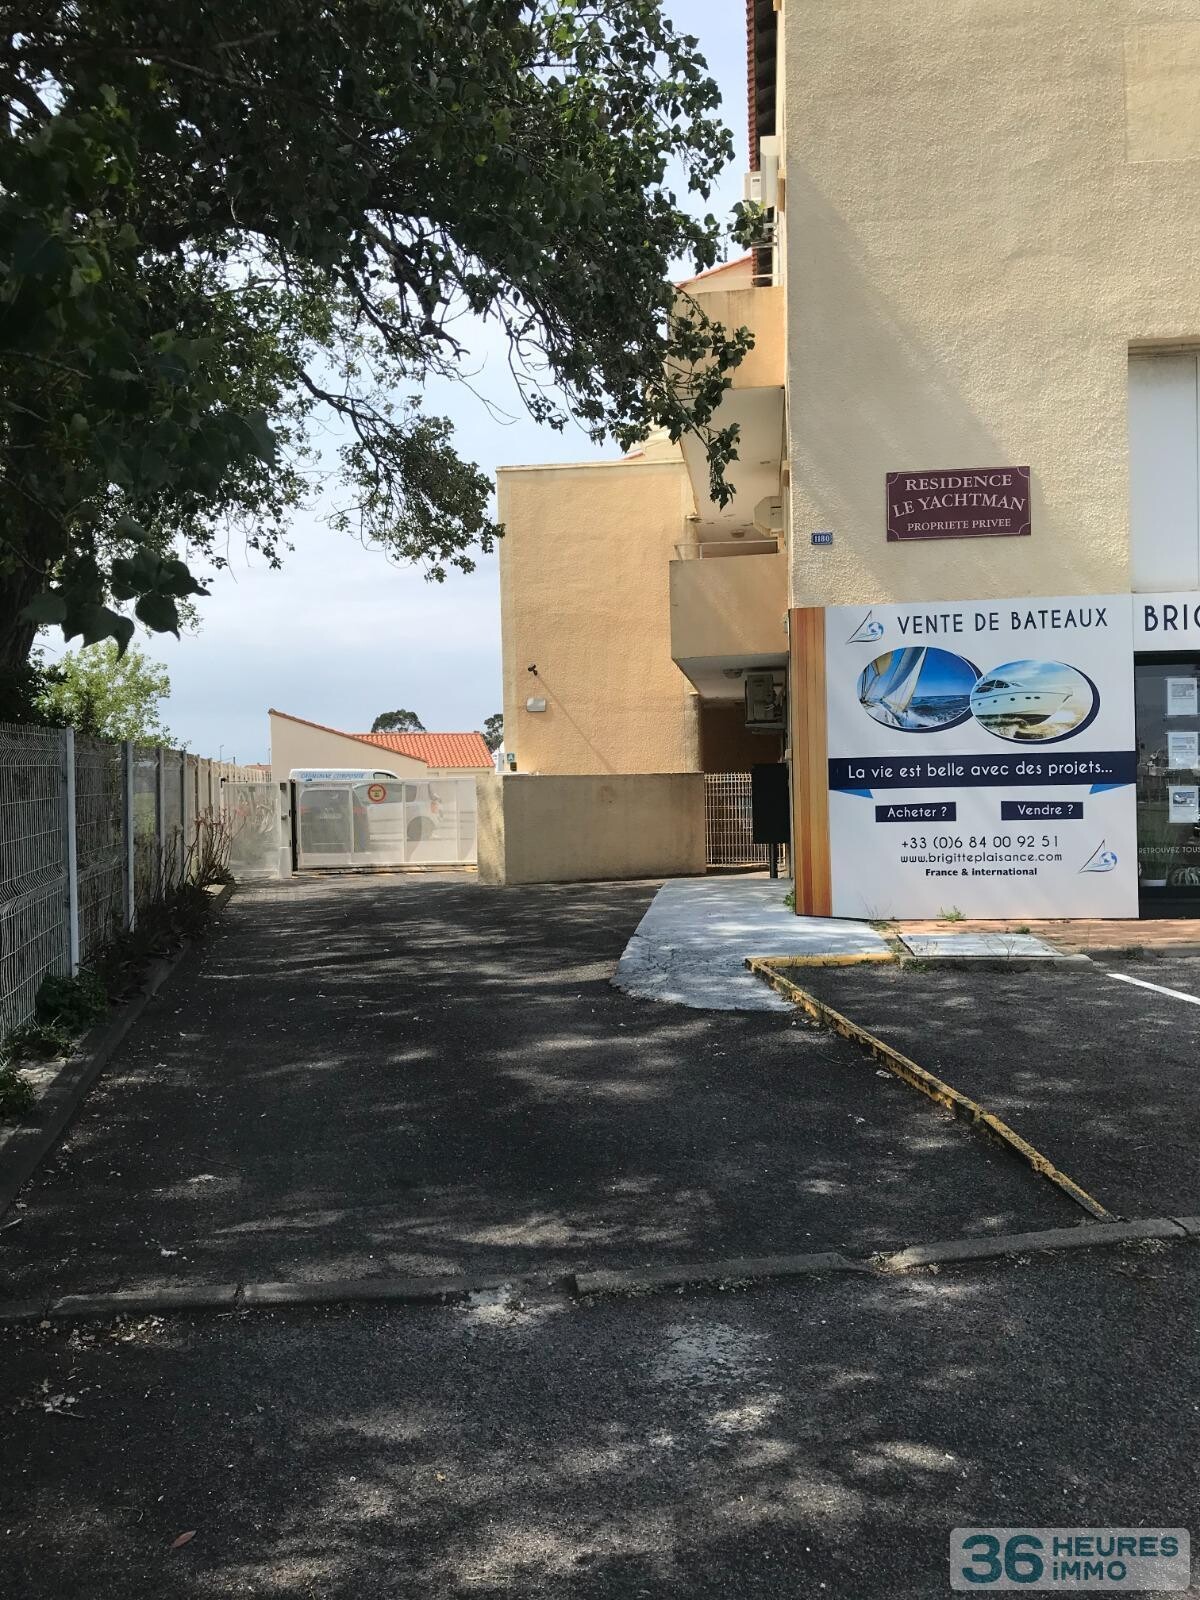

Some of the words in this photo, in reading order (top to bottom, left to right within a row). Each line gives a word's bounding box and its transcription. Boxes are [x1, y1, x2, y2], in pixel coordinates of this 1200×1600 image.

[905, 474, 1012, 491] RESIDENCE
[892, 500, 915, 518] LE
[917, 493, 1027, 512] YACHTMAN
[907, 520, 969, 532] PROPRIETE
[972, 518, 1011, 528] PRIVEE
[897, 613, 963, 635] VENTE
[975, 612, 999, 631] DE
[1011, 608, 1108, 630] BATEAUX
[848, 765, 865, 779] La
[871, 765, 893, 778] vie
[899, 765, 921, 777] est
[927, 763, 965, 777] belle
[970, 764, 1009, 776] avec
[1015, 761, 1042, 775] des
[1048, 760, 1113, 777] projets...
[887, 806, 936, 818] Acheter
[941, 806, 947, 816] ?
[1017, 804, 1062, 816] Vendre
[1067, 804, 1073, 815] ?
[901, 836, 927, 849] +33
[933, 835, 963, 849] (0)6
[968, 836, 987, 848] 84
[992, 836, 1011, 848] 00
[1017, 835, 1035, 848] 92
[1041, 835, 1058, 847] 51
[900, 851, 1062, 865] www.brigitteplaisance.com
[925, 868, 959, 877] France
[961, 868, 969, 876] &
[971, 867, 1037, 876] international
